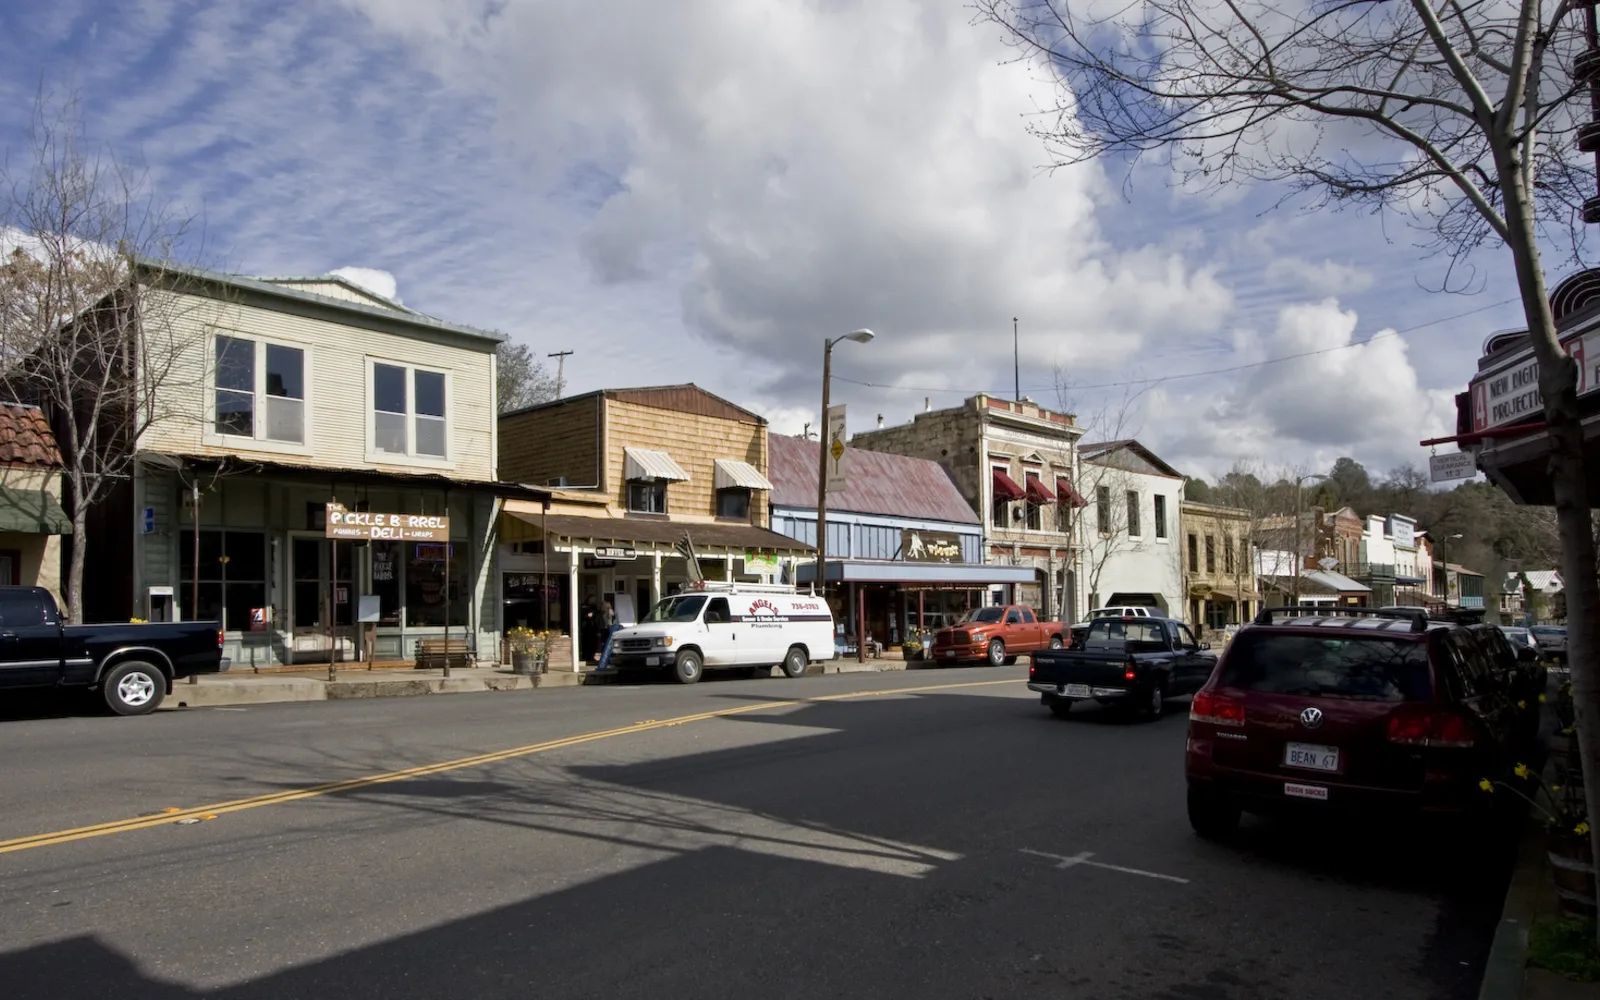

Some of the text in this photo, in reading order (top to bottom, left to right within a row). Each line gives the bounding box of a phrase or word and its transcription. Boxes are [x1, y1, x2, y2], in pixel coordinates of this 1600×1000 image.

[1490, 363, 1540, 399] NEW DIGIT
[1476, 385, 1487, 428] 4
[1492, 389, 1545, 422] PROJECTIO
[1433, 460, 1472, 471] CLEARANCE
[1436, 454, 1469, 464] VERTICAL
[331, 511, 446, 529] PICKLE BRREL
[370, 526, 404, 539] DELI
[749, 599, 779, 616] ANGELS
[1291, 750, 1336, 768] BEAN 67
